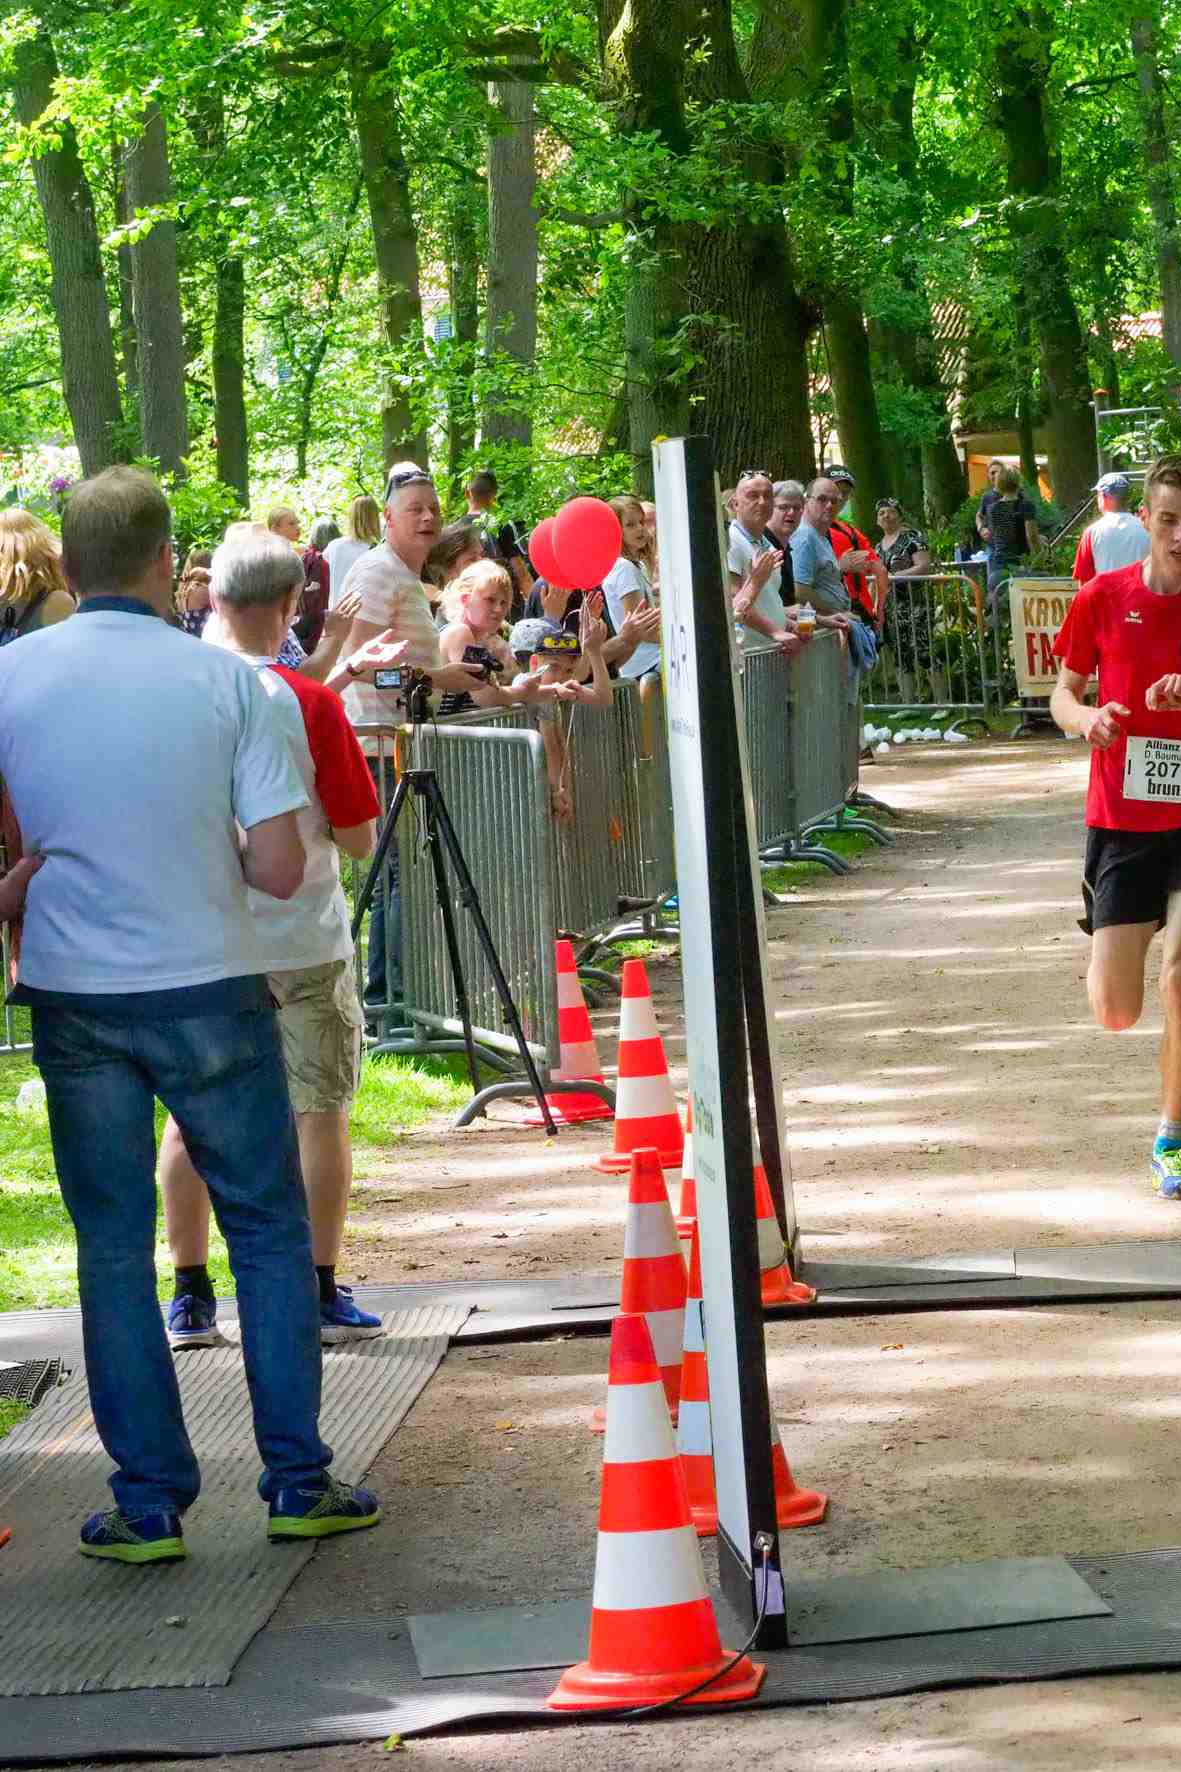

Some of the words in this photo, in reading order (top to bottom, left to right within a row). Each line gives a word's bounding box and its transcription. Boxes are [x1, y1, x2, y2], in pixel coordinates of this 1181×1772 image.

[1025, 632, 1062, 676] FA
[1145, 740, 1181, 752] Allianz
[1144, 750, 1155, 759] D.
